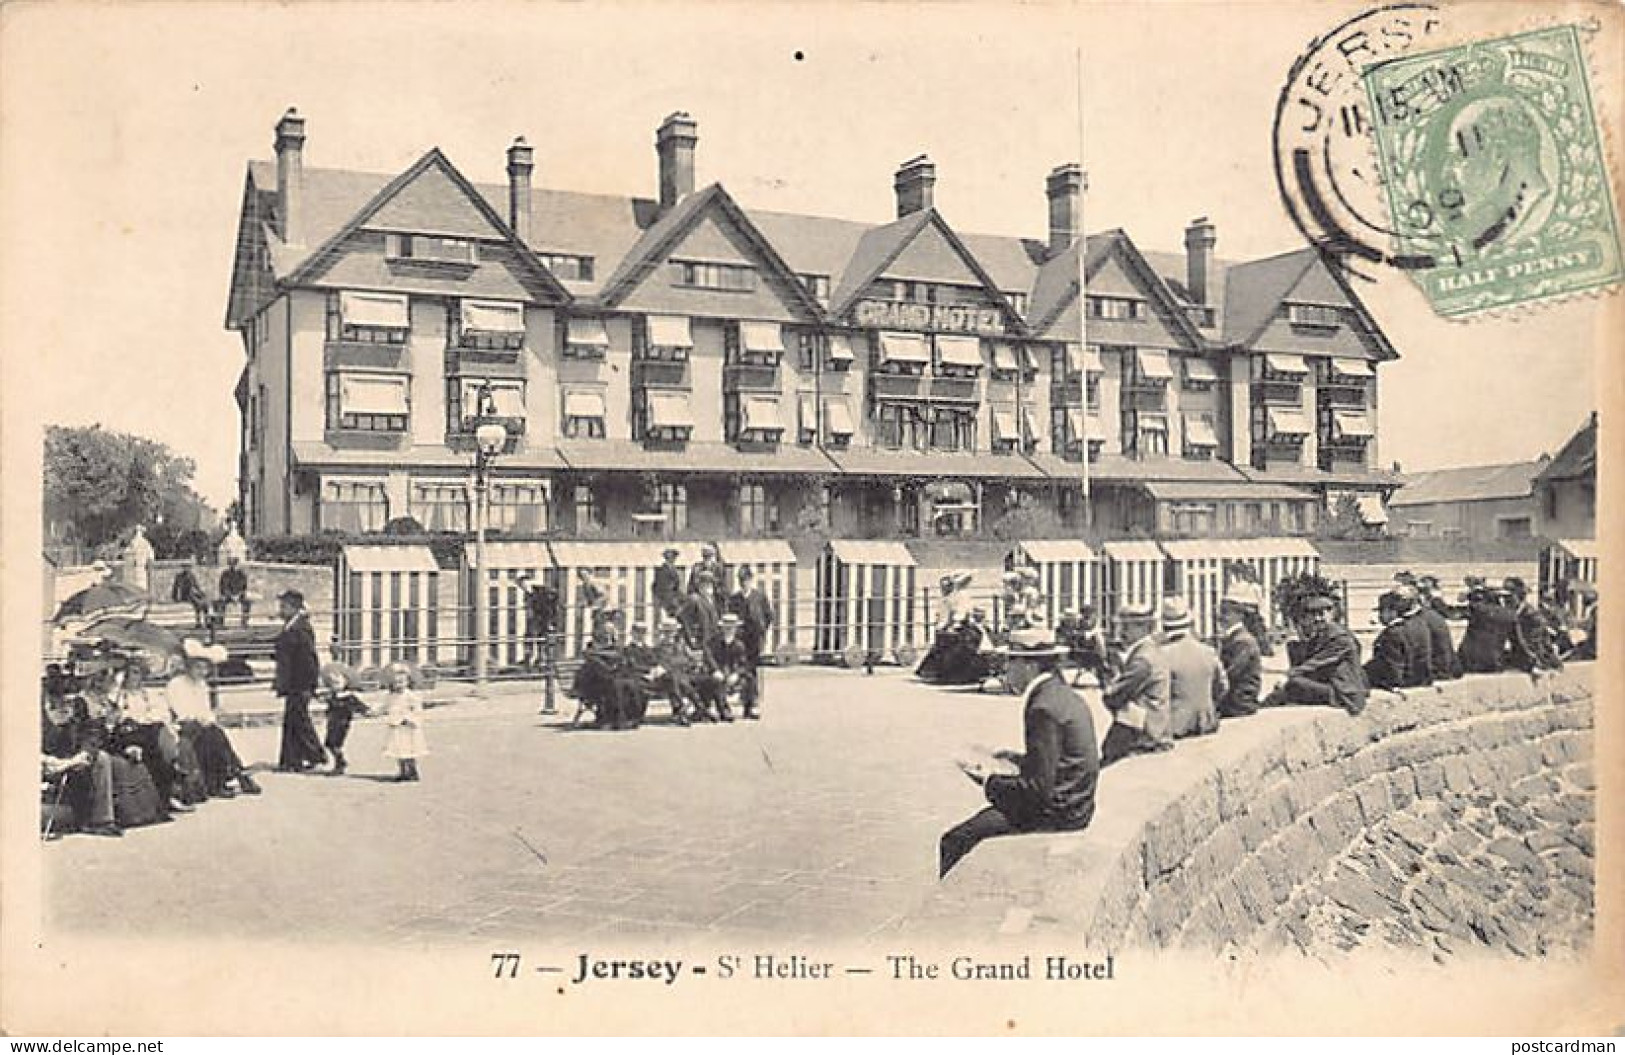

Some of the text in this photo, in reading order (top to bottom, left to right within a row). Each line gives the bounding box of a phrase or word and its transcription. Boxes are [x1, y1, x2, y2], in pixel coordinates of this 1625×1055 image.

[856, 300, 1006, 337] GRAND HOTEL
[490, 953, 521, 979] 77
[572, 953, 683, 985] Jersey
[754, 954, 834, 979] Helier
[886, 955, 939, 980] The
[951, 955, 1031, 980] Grand
[1045, 955, 1115, 980] Hotel
